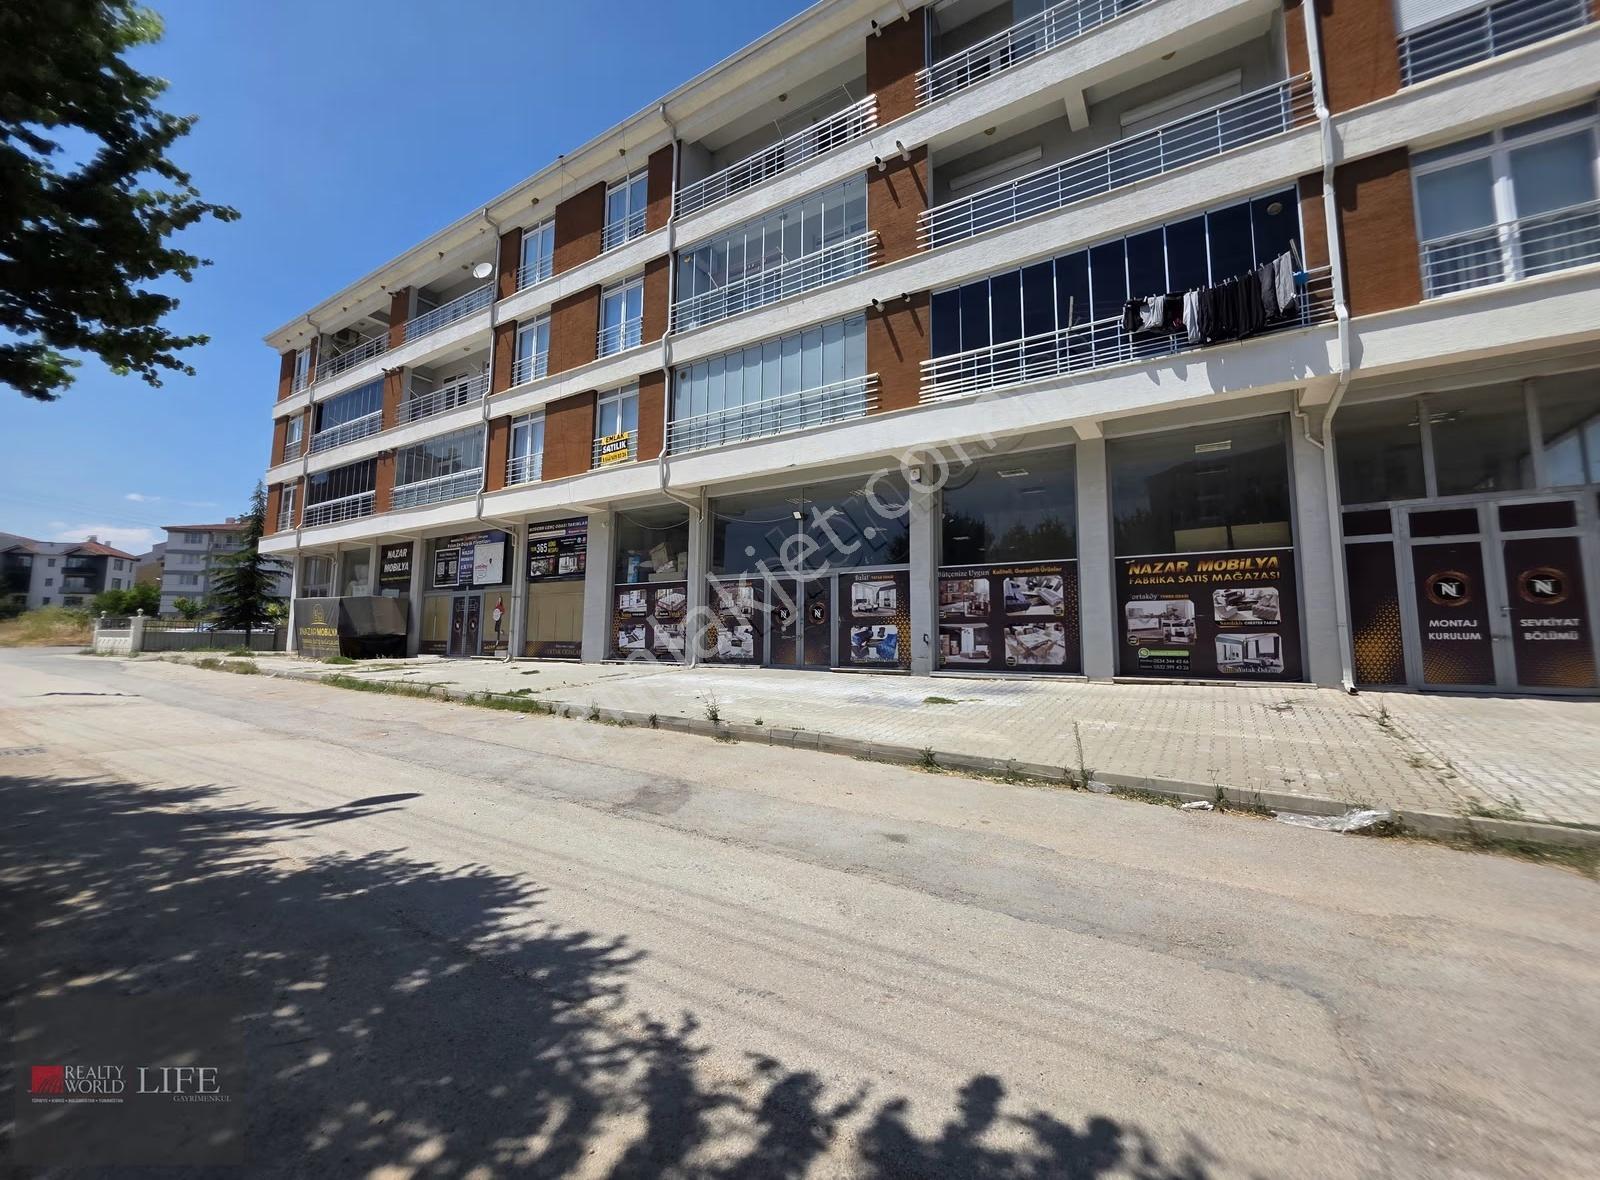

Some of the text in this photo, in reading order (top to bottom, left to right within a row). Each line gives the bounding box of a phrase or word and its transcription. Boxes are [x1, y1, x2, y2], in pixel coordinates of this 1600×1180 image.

[605, 433, 625, 443] EMLAK
[602, 440, 627, 454] SATILIK
[536, 542, 548, 553] 365
[387, 548, 408, 558] NAZAR
[1128, 560, 1188, 576] NAZAR
[968, 569, 990, 578] Uygun
[1178, 573, 1208, 584] SATIŞ
[1212, 570, 1280, 582] MAĞAZASI
[1524, 631, 1579, 640] BÖLÜMÜ
